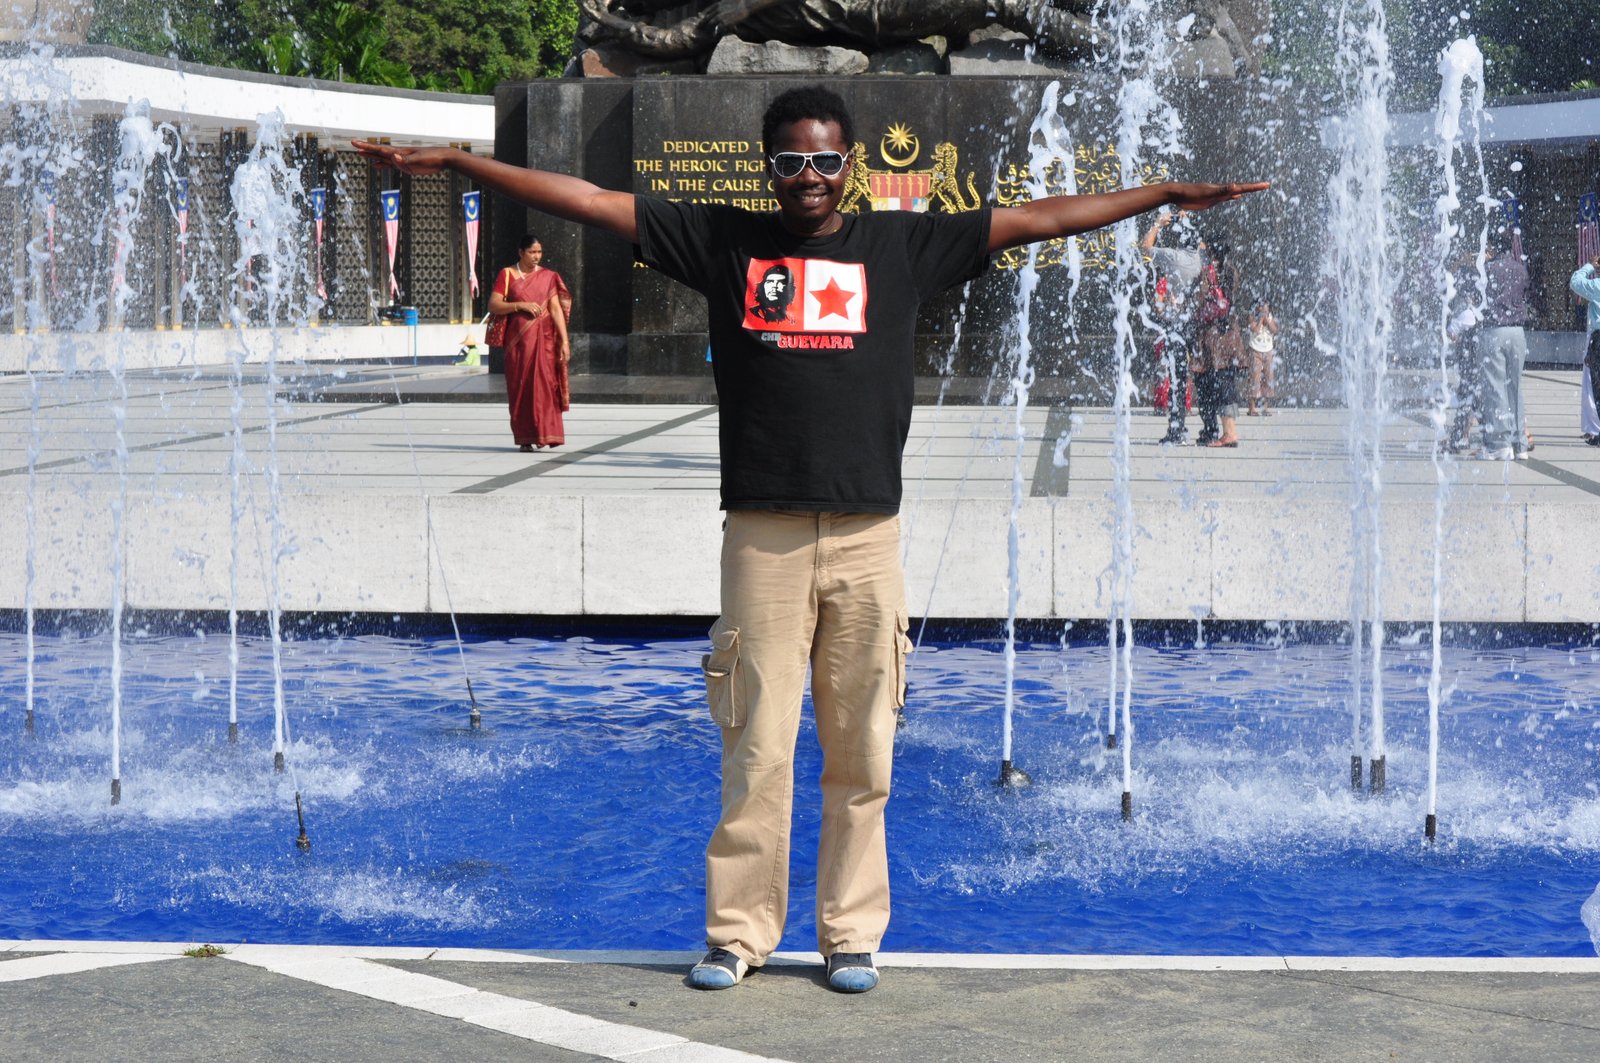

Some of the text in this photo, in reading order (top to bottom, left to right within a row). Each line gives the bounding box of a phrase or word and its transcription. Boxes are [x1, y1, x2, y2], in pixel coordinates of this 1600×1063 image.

[663, 141, 764, 153] DEDICATED T
[634, 160, 663, 172] THE
[670, 160, 728, 172] HEROIC
[651, 179, 670, 191] IN
[676, 179, 706, 191] THE
[712, 179, 760, 191] CAUSE
[732, 198, 780, 211] FREED
[777, 335, 854, 349] GUEVARA
